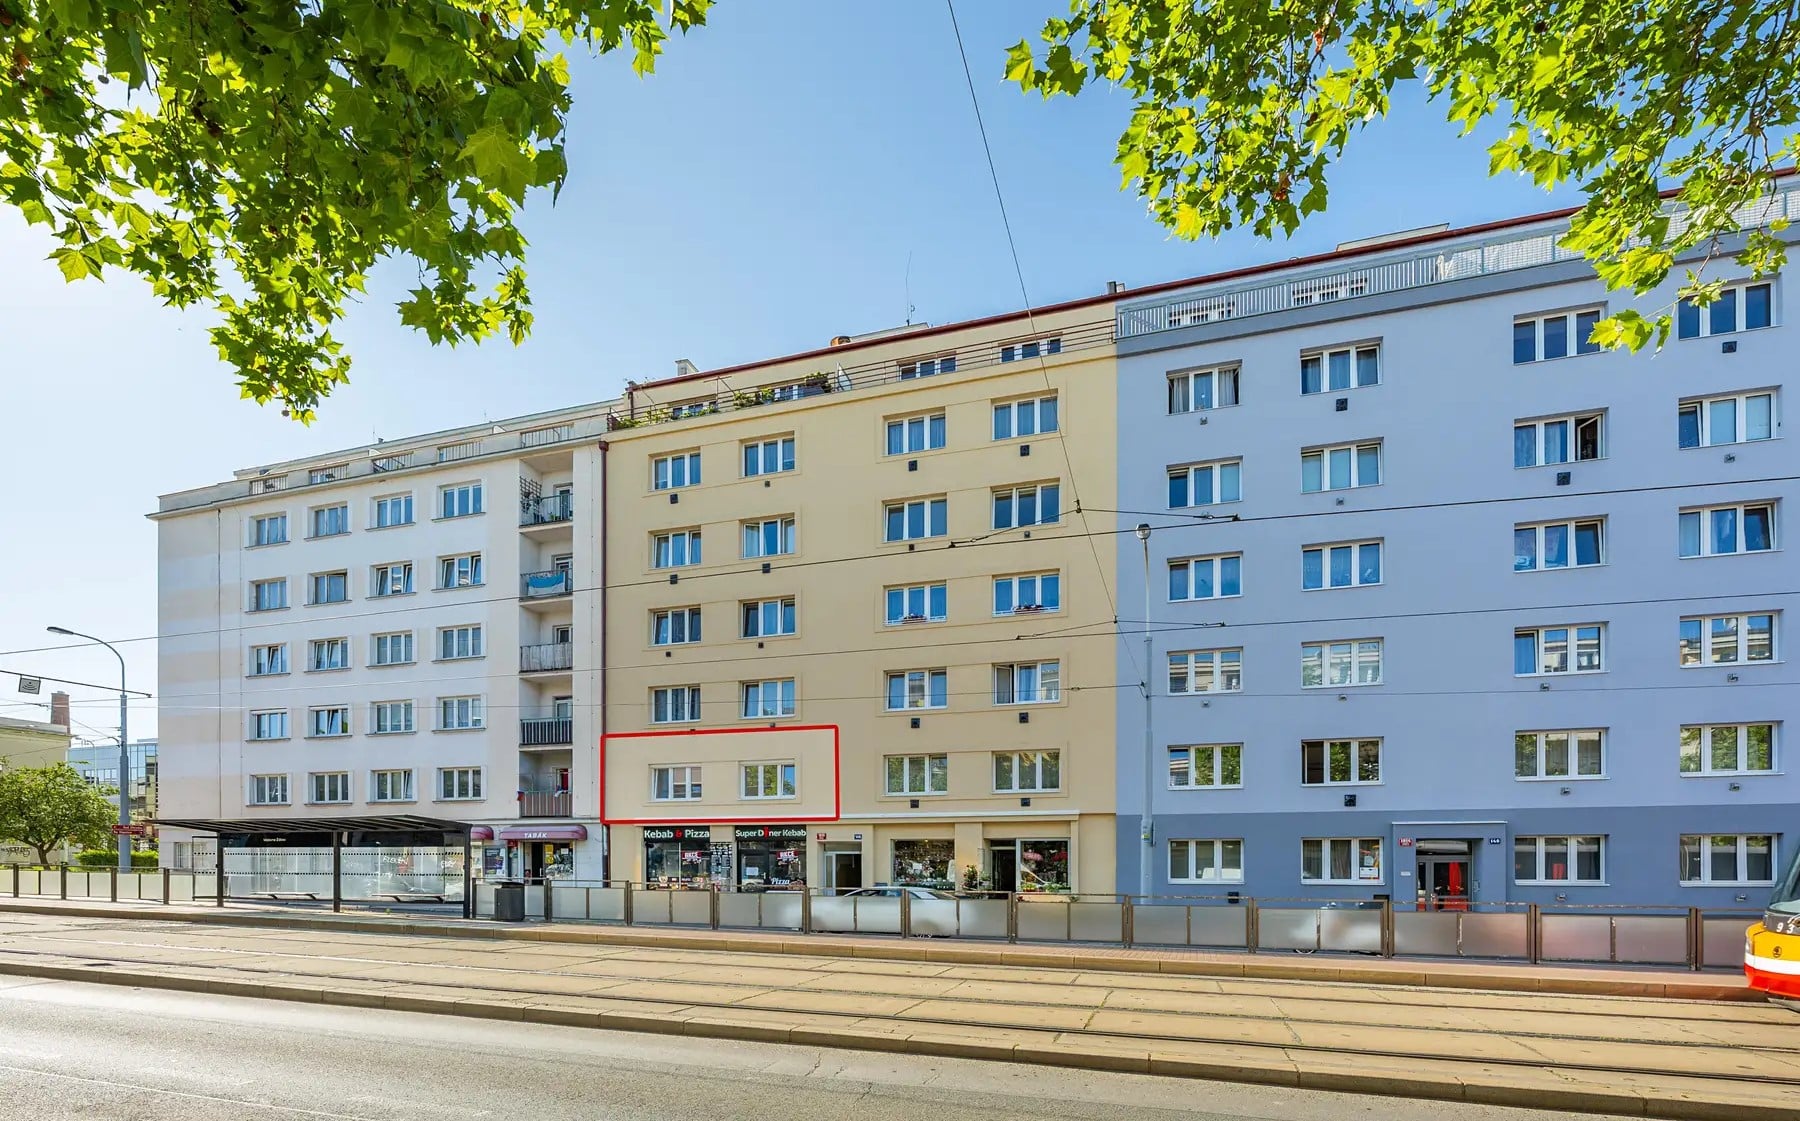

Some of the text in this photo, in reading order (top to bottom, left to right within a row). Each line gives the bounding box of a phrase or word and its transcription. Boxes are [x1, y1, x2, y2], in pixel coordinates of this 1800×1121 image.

[644, 830, 674, 838] Kebab
[684, 829, 710, 838] Pizza
[735, 829, 757, 838] Super
[782, 829, 807, 837] Kebab
[771, 877, 791, 885] Pizza
